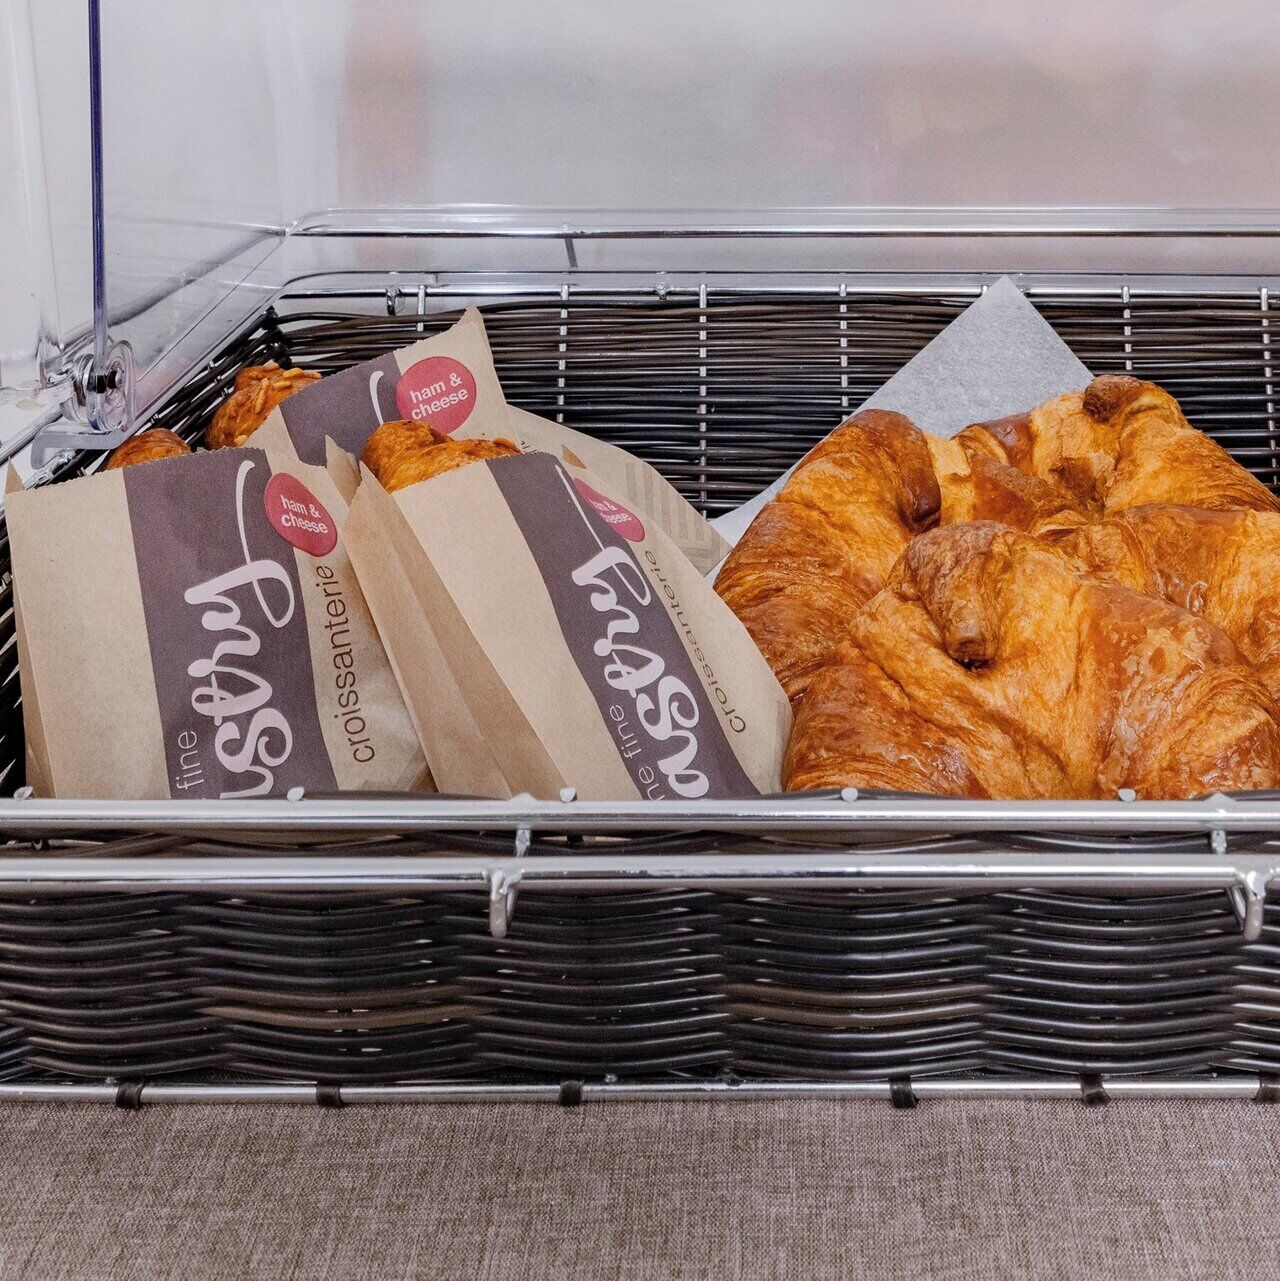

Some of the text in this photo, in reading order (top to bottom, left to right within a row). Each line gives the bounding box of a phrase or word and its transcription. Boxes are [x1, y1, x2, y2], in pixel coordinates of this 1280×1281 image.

[410, 373, 462, 404] ham &
[411, 389, 469, 420] cheese
[280, 494, 321, 518] ham &
[281, 511, 329, 534] cheese
[555, 464, 710, 798] astry
[645, 549, 746, 734] croissanterie
[316, 565, 375, 763] croissanterie
[176, 730, 204, 790] fine
[609, 704, 642, 760] fine
